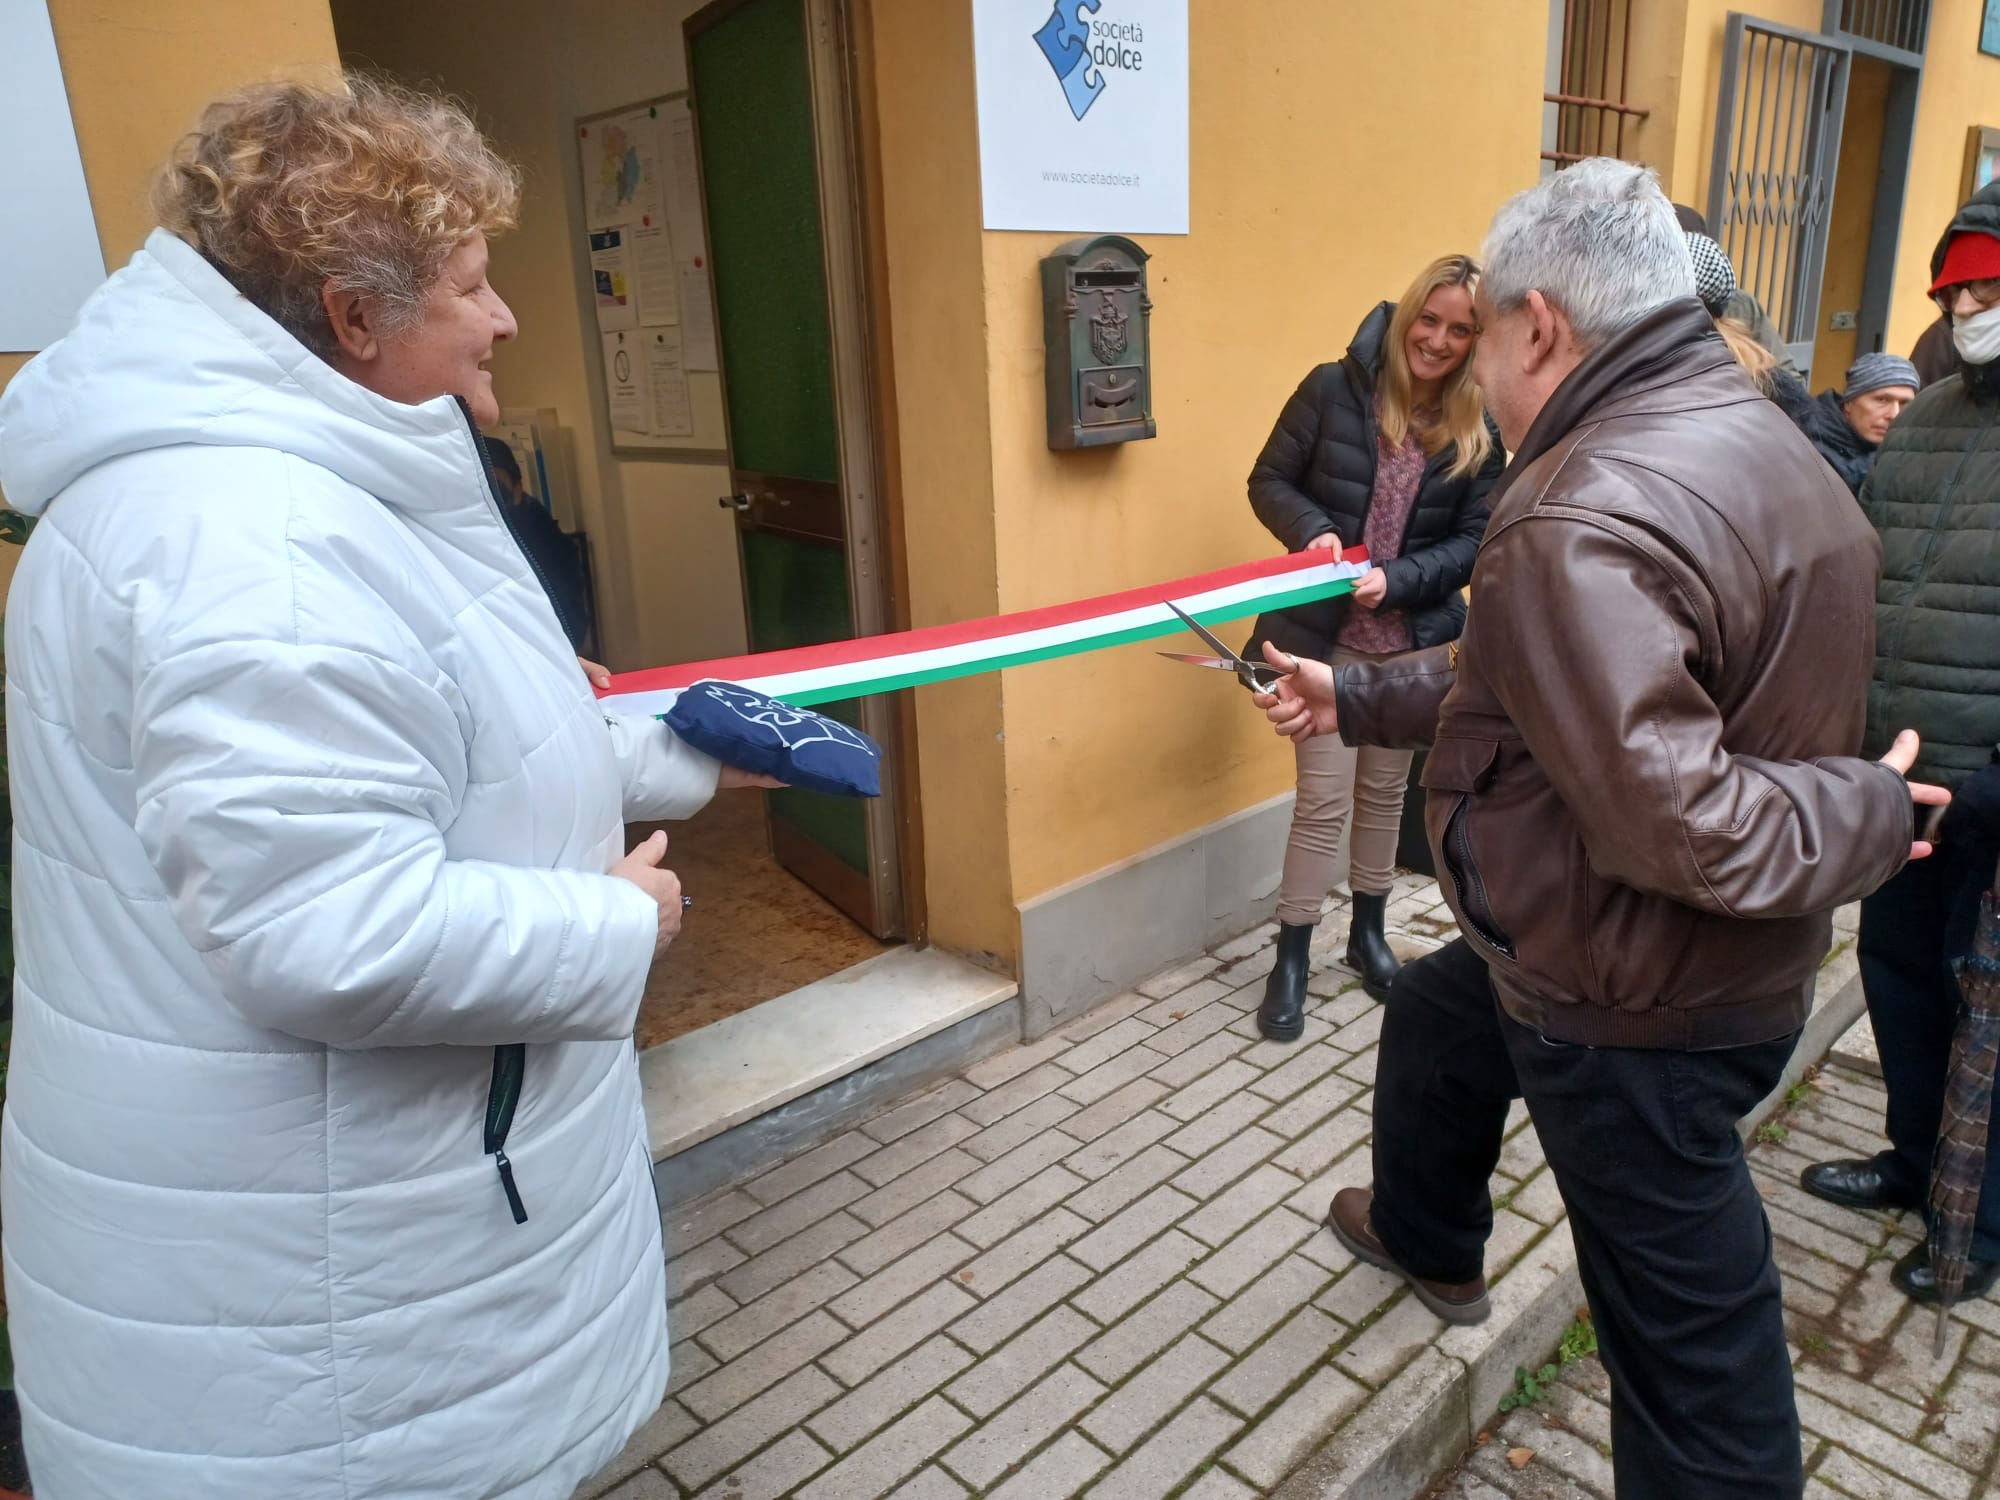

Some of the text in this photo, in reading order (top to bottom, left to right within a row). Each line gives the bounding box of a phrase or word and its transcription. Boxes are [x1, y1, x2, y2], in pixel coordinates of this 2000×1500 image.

[1093, 20, 1143, 43] società
[1093, 40, 1143, 71] dolce
[1042, 170, 1140, 188] www.societadolce.it
